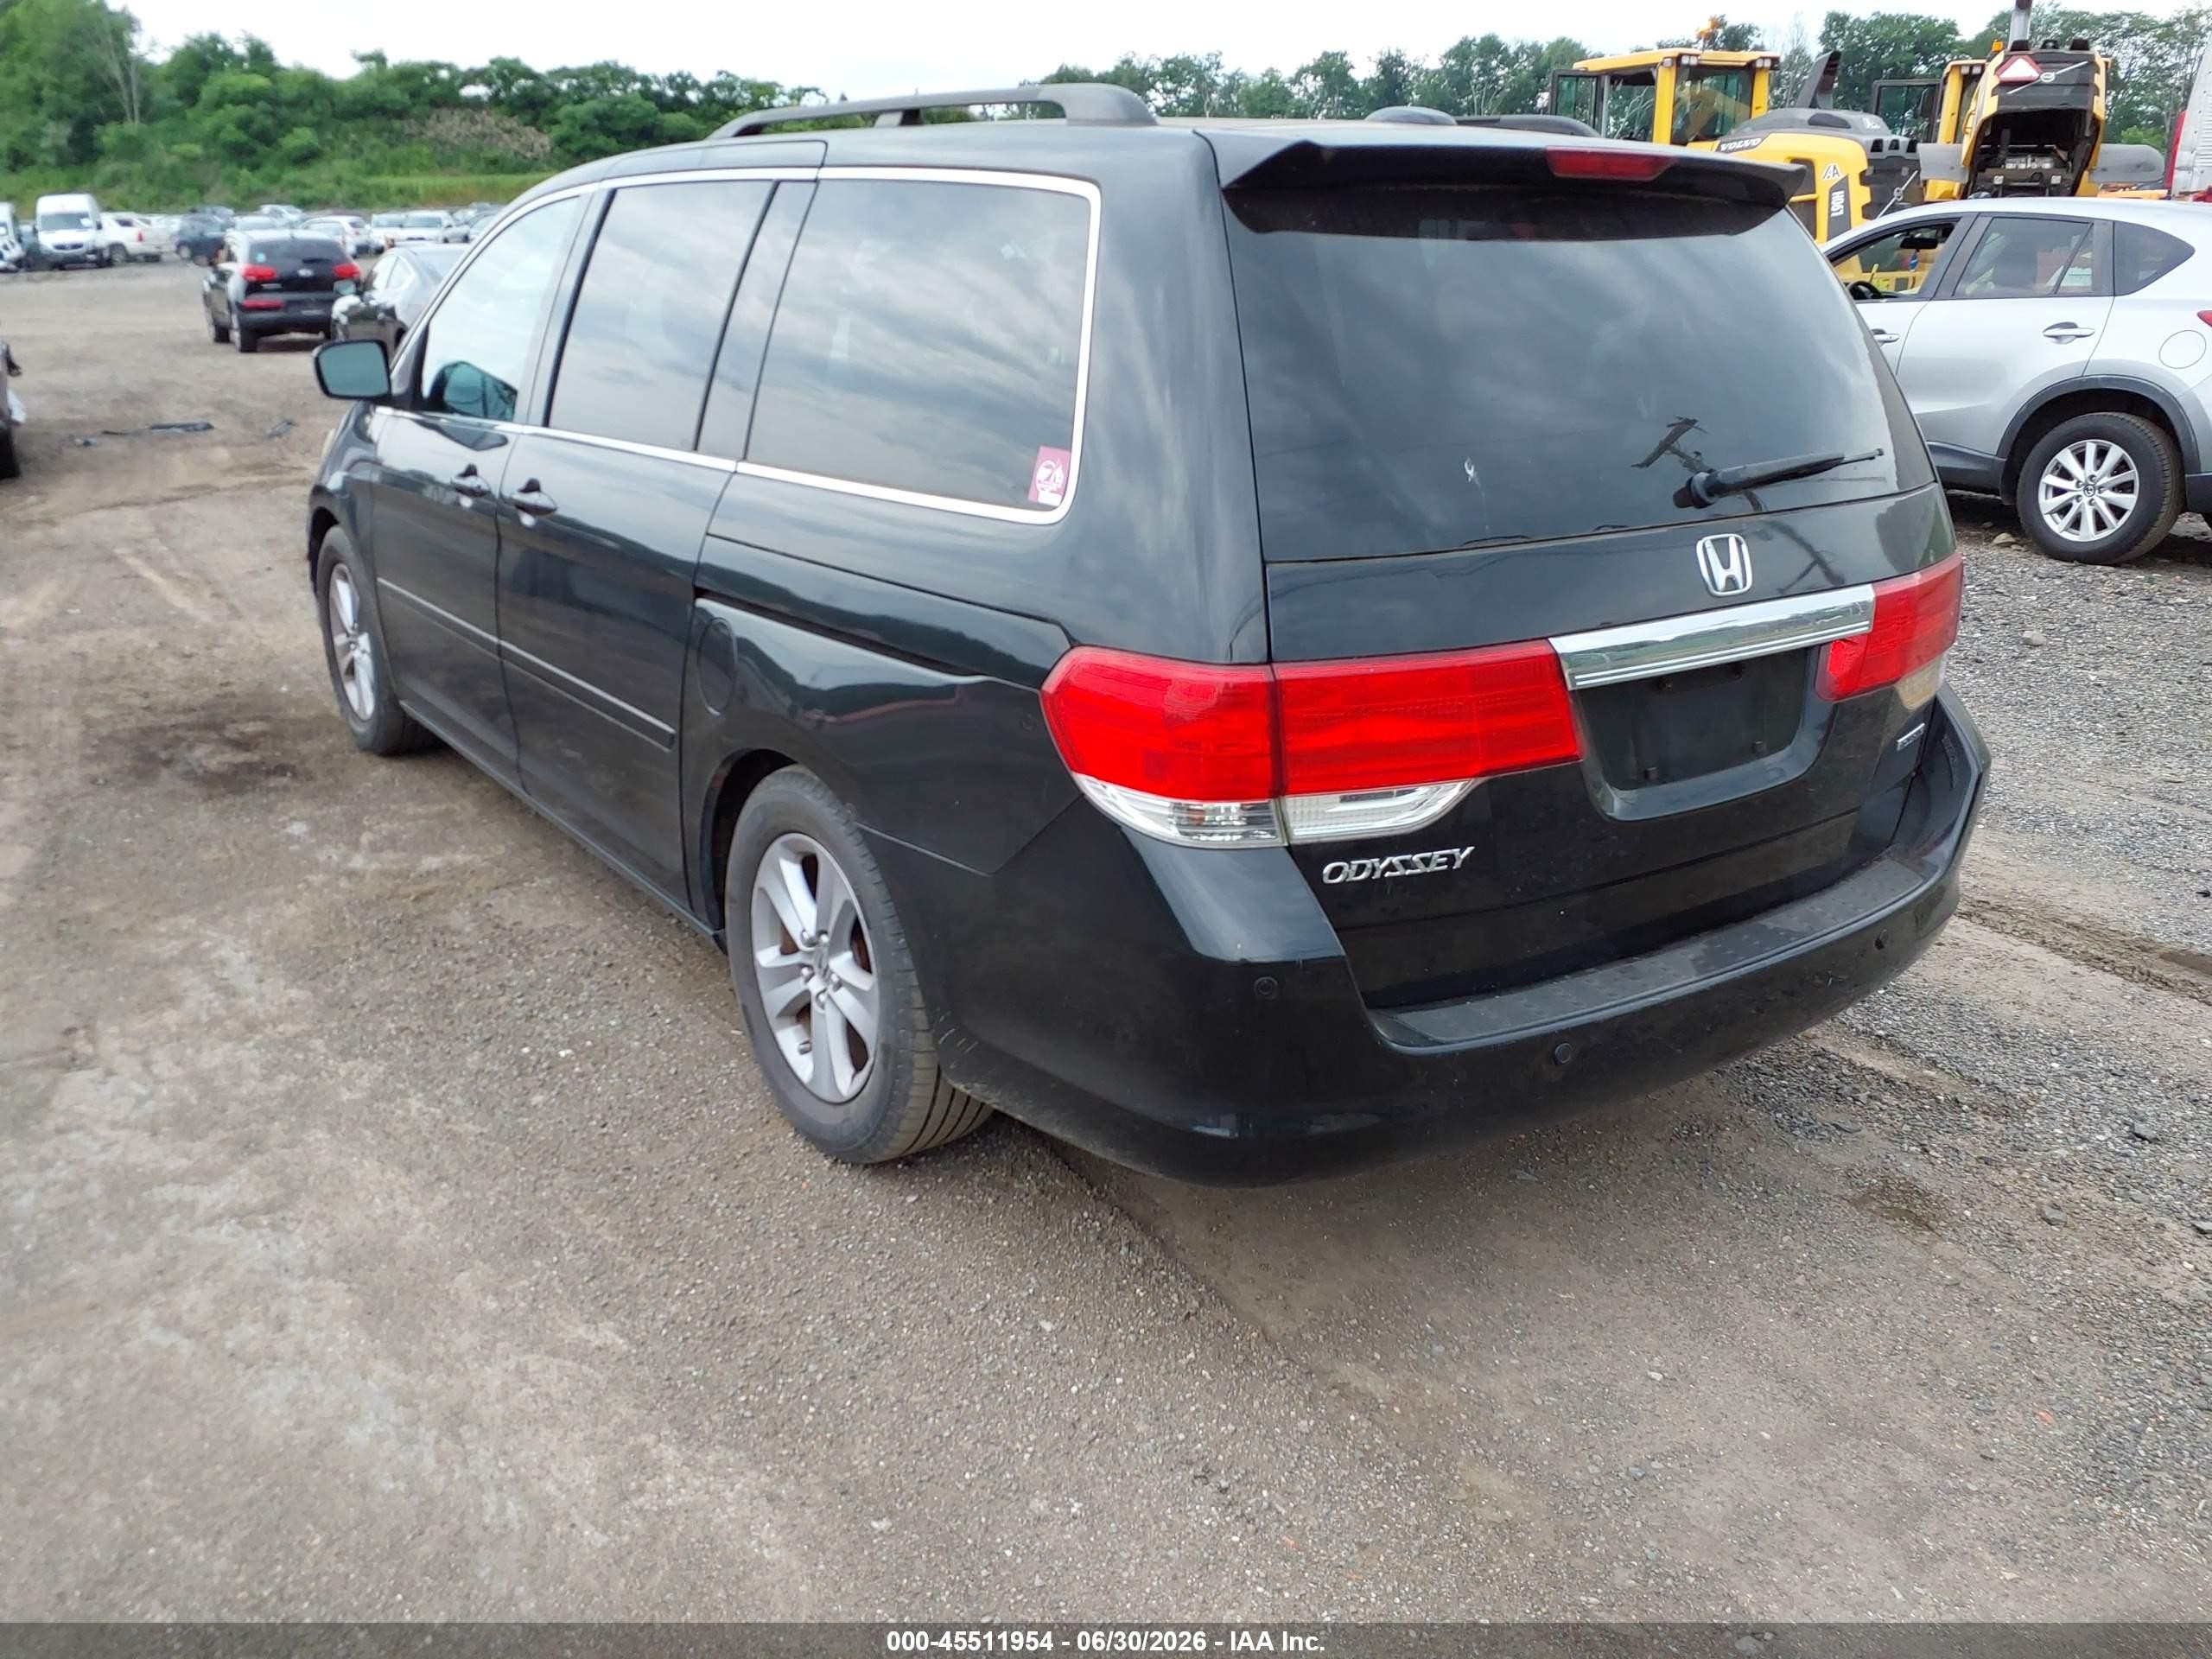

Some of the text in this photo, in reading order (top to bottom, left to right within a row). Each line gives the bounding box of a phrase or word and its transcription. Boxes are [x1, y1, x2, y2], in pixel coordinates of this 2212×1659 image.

[1720, 137, 1762, 151] VOLVO
[1830, 190, 1845, 217] L90H
[1322, 846, 1475, 884] ODYSSEY
